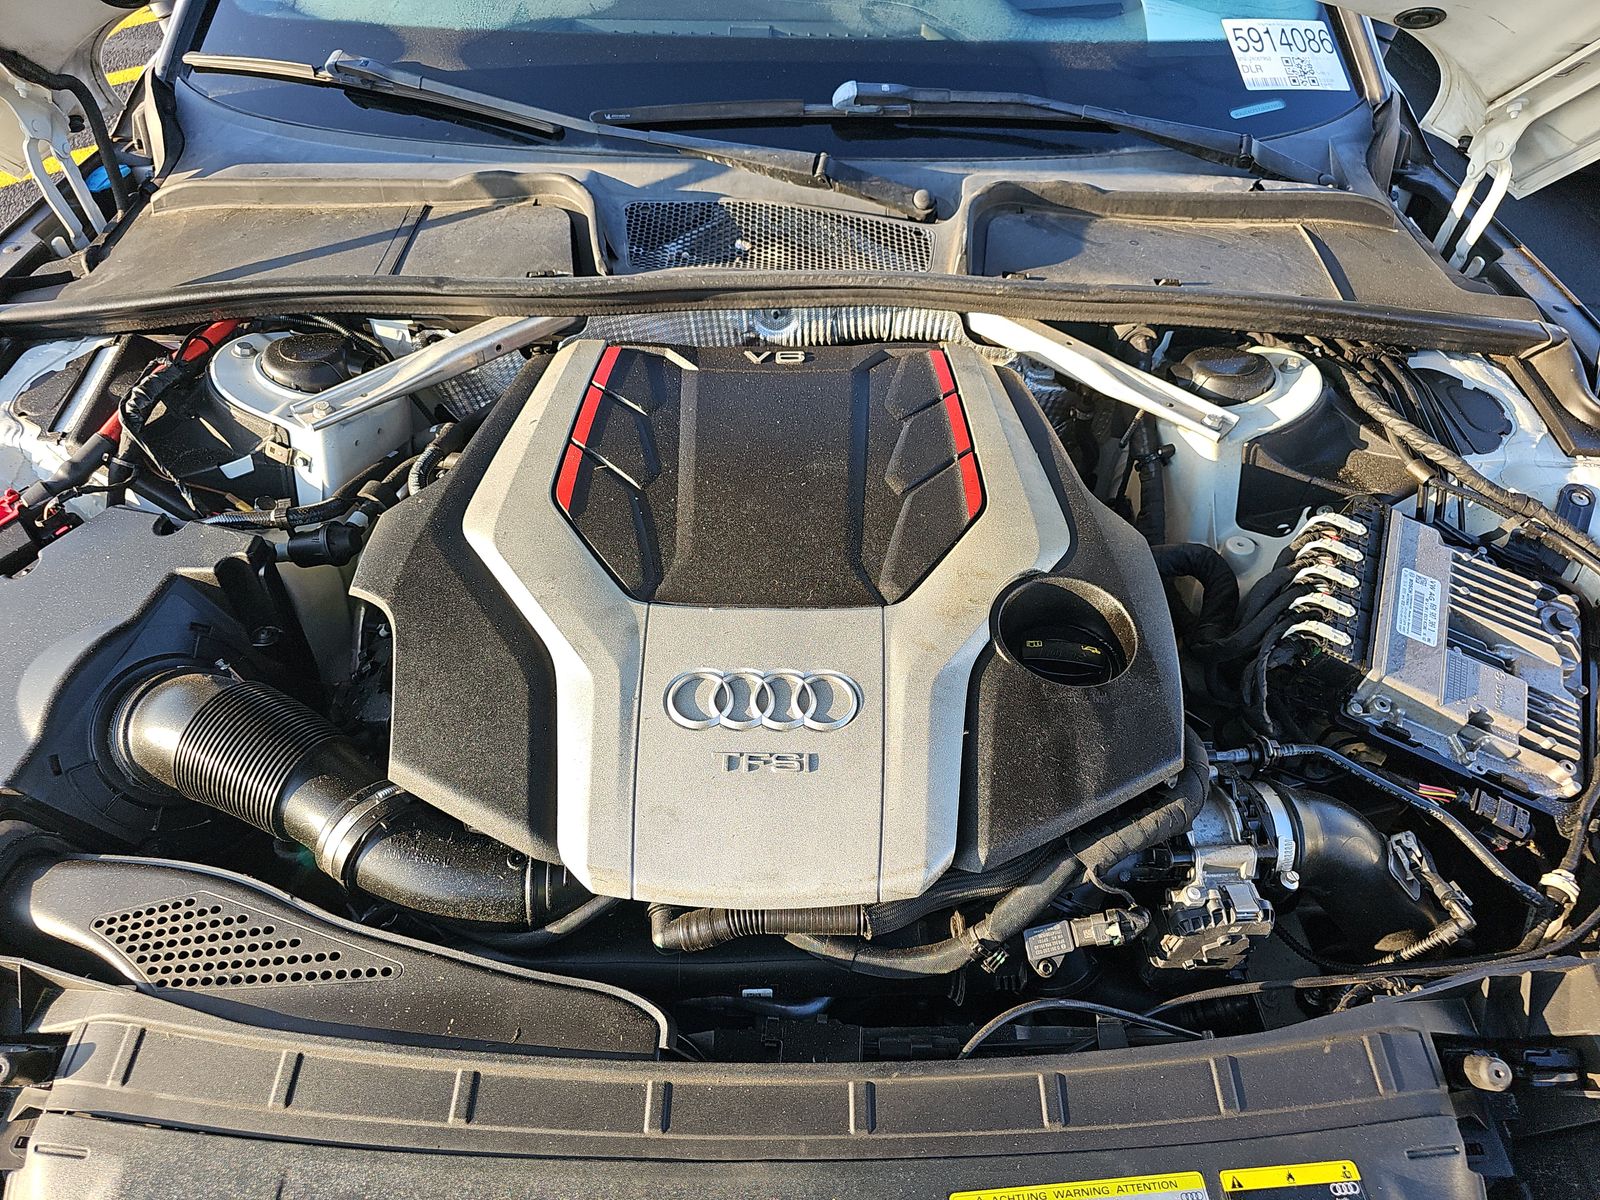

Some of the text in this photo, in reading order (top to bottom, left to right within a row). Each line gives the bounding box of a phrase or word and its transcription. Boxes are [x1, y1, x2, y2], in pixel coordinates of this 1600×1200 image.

[1232, 27, 1334, 53] 5914086
[1241, 64, 1264, 74] DLR
[743, 350, 806, 365] V6
[714, 752, 810, 773] TFSI
[1053, 1186, 1110, 1199] WARNING
[1116, 1180, 1178, 1193] ATTENTION
